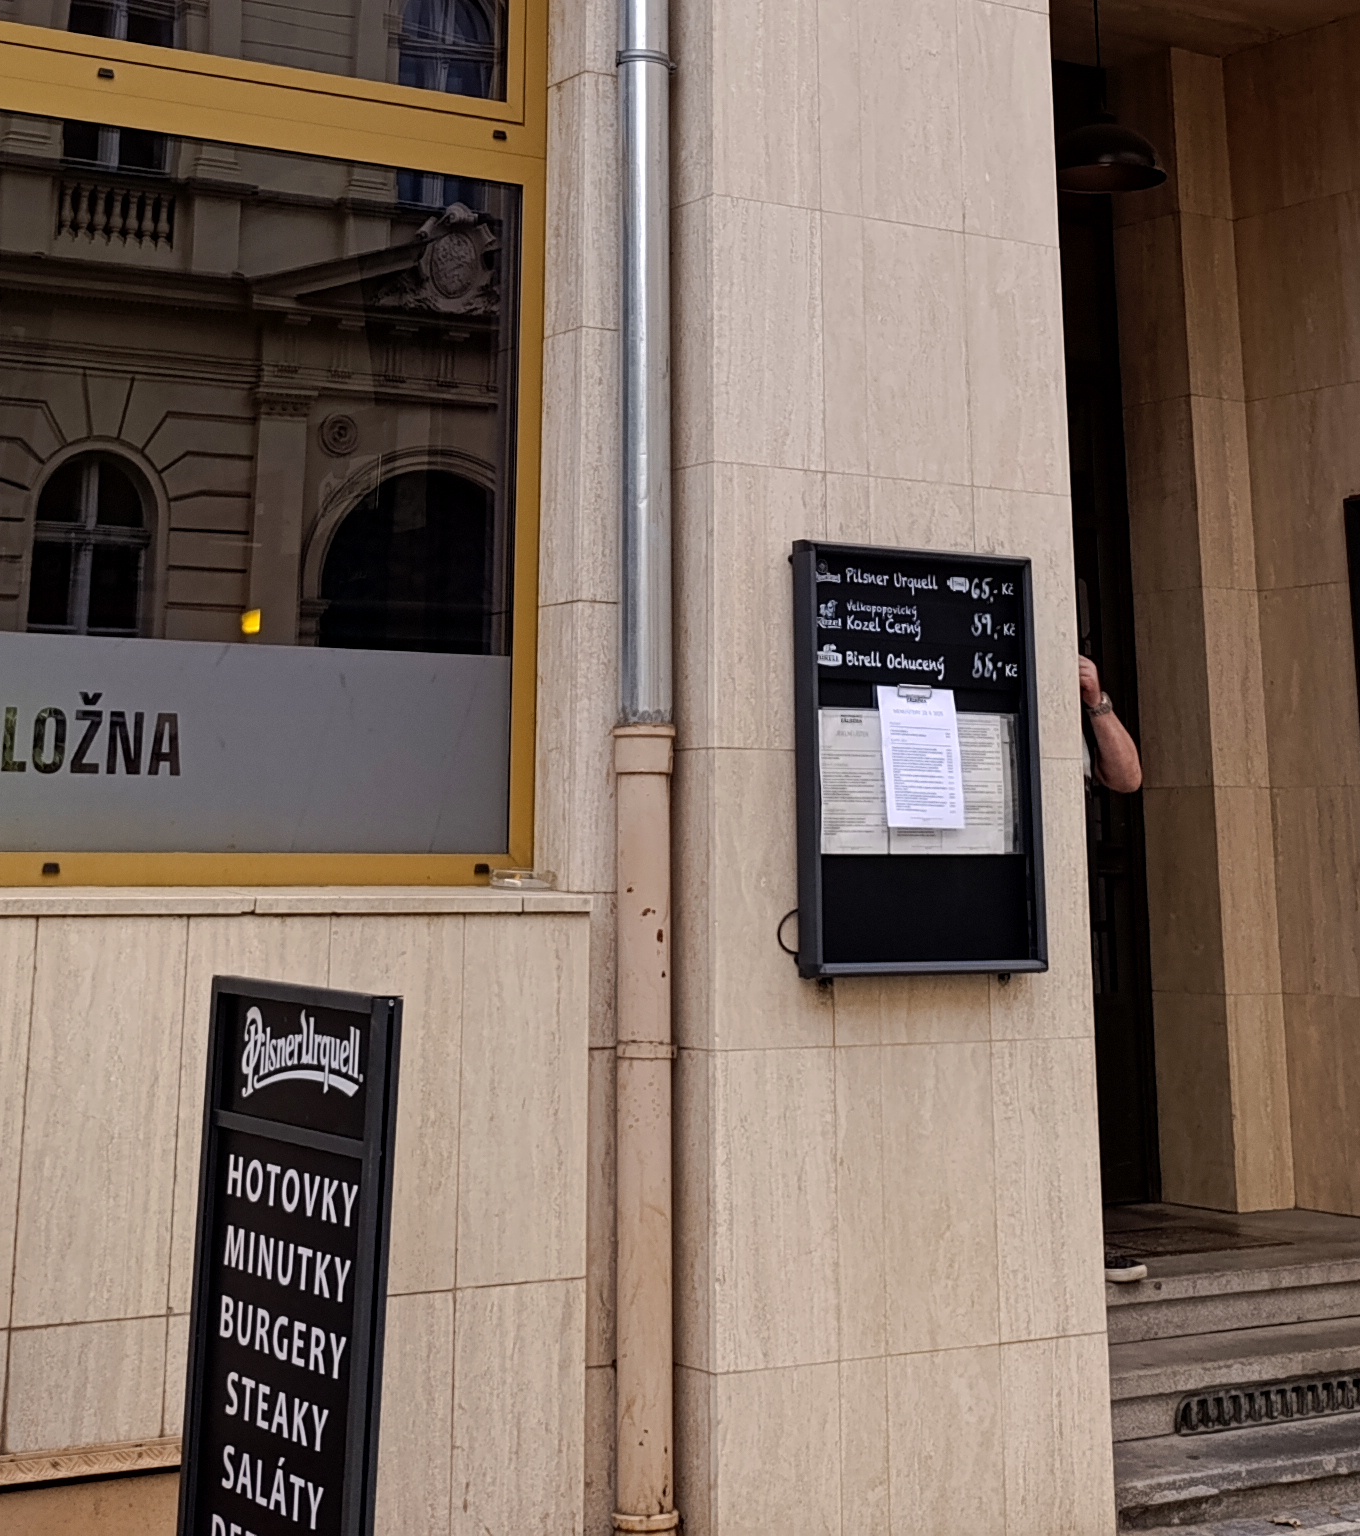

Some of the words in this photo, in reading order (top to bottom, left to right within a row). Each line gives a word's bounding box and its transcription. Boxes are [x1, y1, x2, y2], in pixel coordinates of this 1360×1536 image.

[846, 568, 889, 586] Pilsner
[893, 572, 938, 596] Urquell
[1001, 582, 1015, 596] Kč
[846, 602, 917, 621] Velkopopovický
[846, 615, 881, 632] Kozel
[885, 614, 921, 641] Černý
[1003, 623, 1016, 636] Kč
[846, 651, 881, 668] Birell
[887, 654, 944, 680] Ochucený
[1005, 664, 1018, 677] Kč
[242, 1006, 302, 1097] Pilsner
[300, 1009, 360, 1094] Urquell
[226, 1154, 358, 1227] HOTOVKY
[224, 1225, 351, 1303] MINUTKY
[219, 1294, 346, 1380] BURGERY
[225, 1371, 329, 1453] STEAKY
[221, 1444, 324, 1531] SALÁTY
